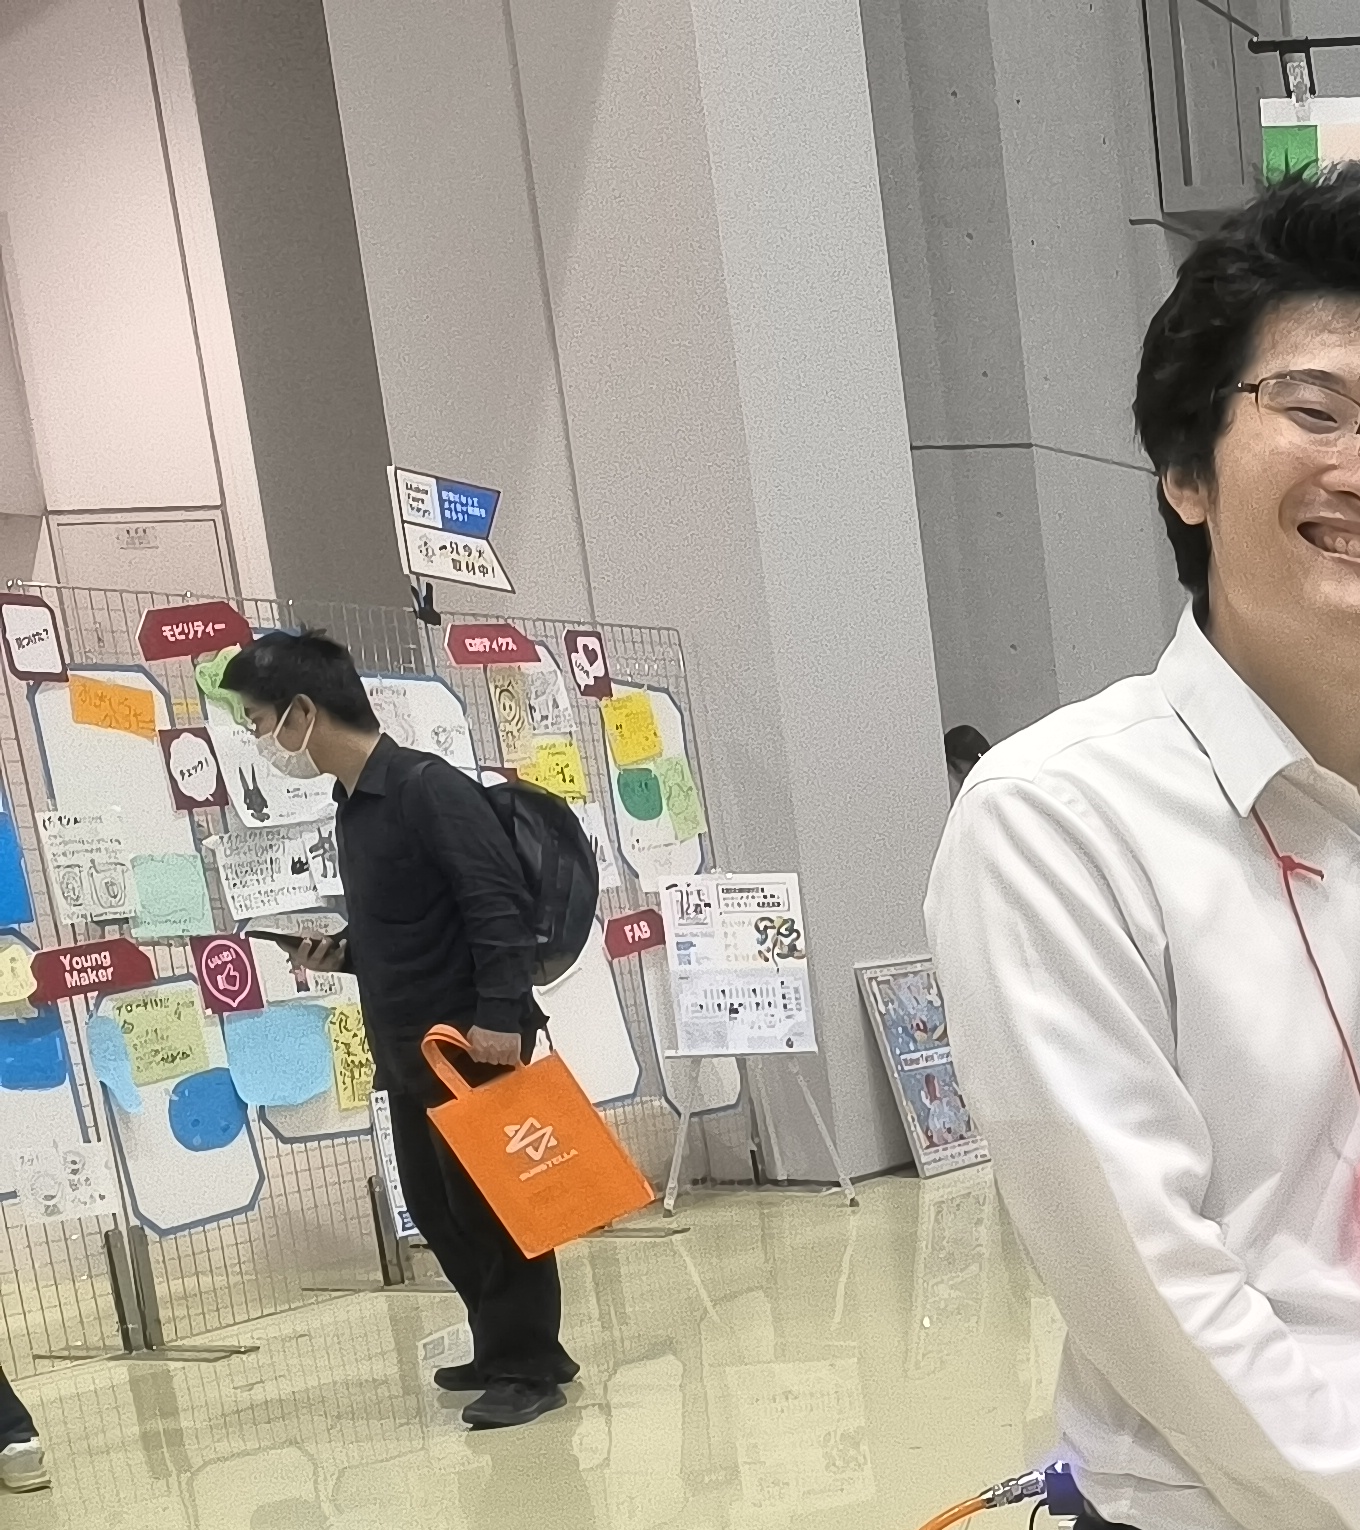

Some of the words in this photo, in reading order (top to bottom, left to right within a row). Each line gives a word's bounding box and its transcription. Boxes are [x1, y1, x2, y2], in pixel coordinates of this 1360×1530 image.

[161, 620, 226, 642] モビリティー
[464, 636, 517, 653] ロボティクス
[179, 756, 210, 782] チェック！
[623, 920, 651, 945] FAB
[60, 950, 112, 972] Young
[65, 965, 115, 989] Maker
